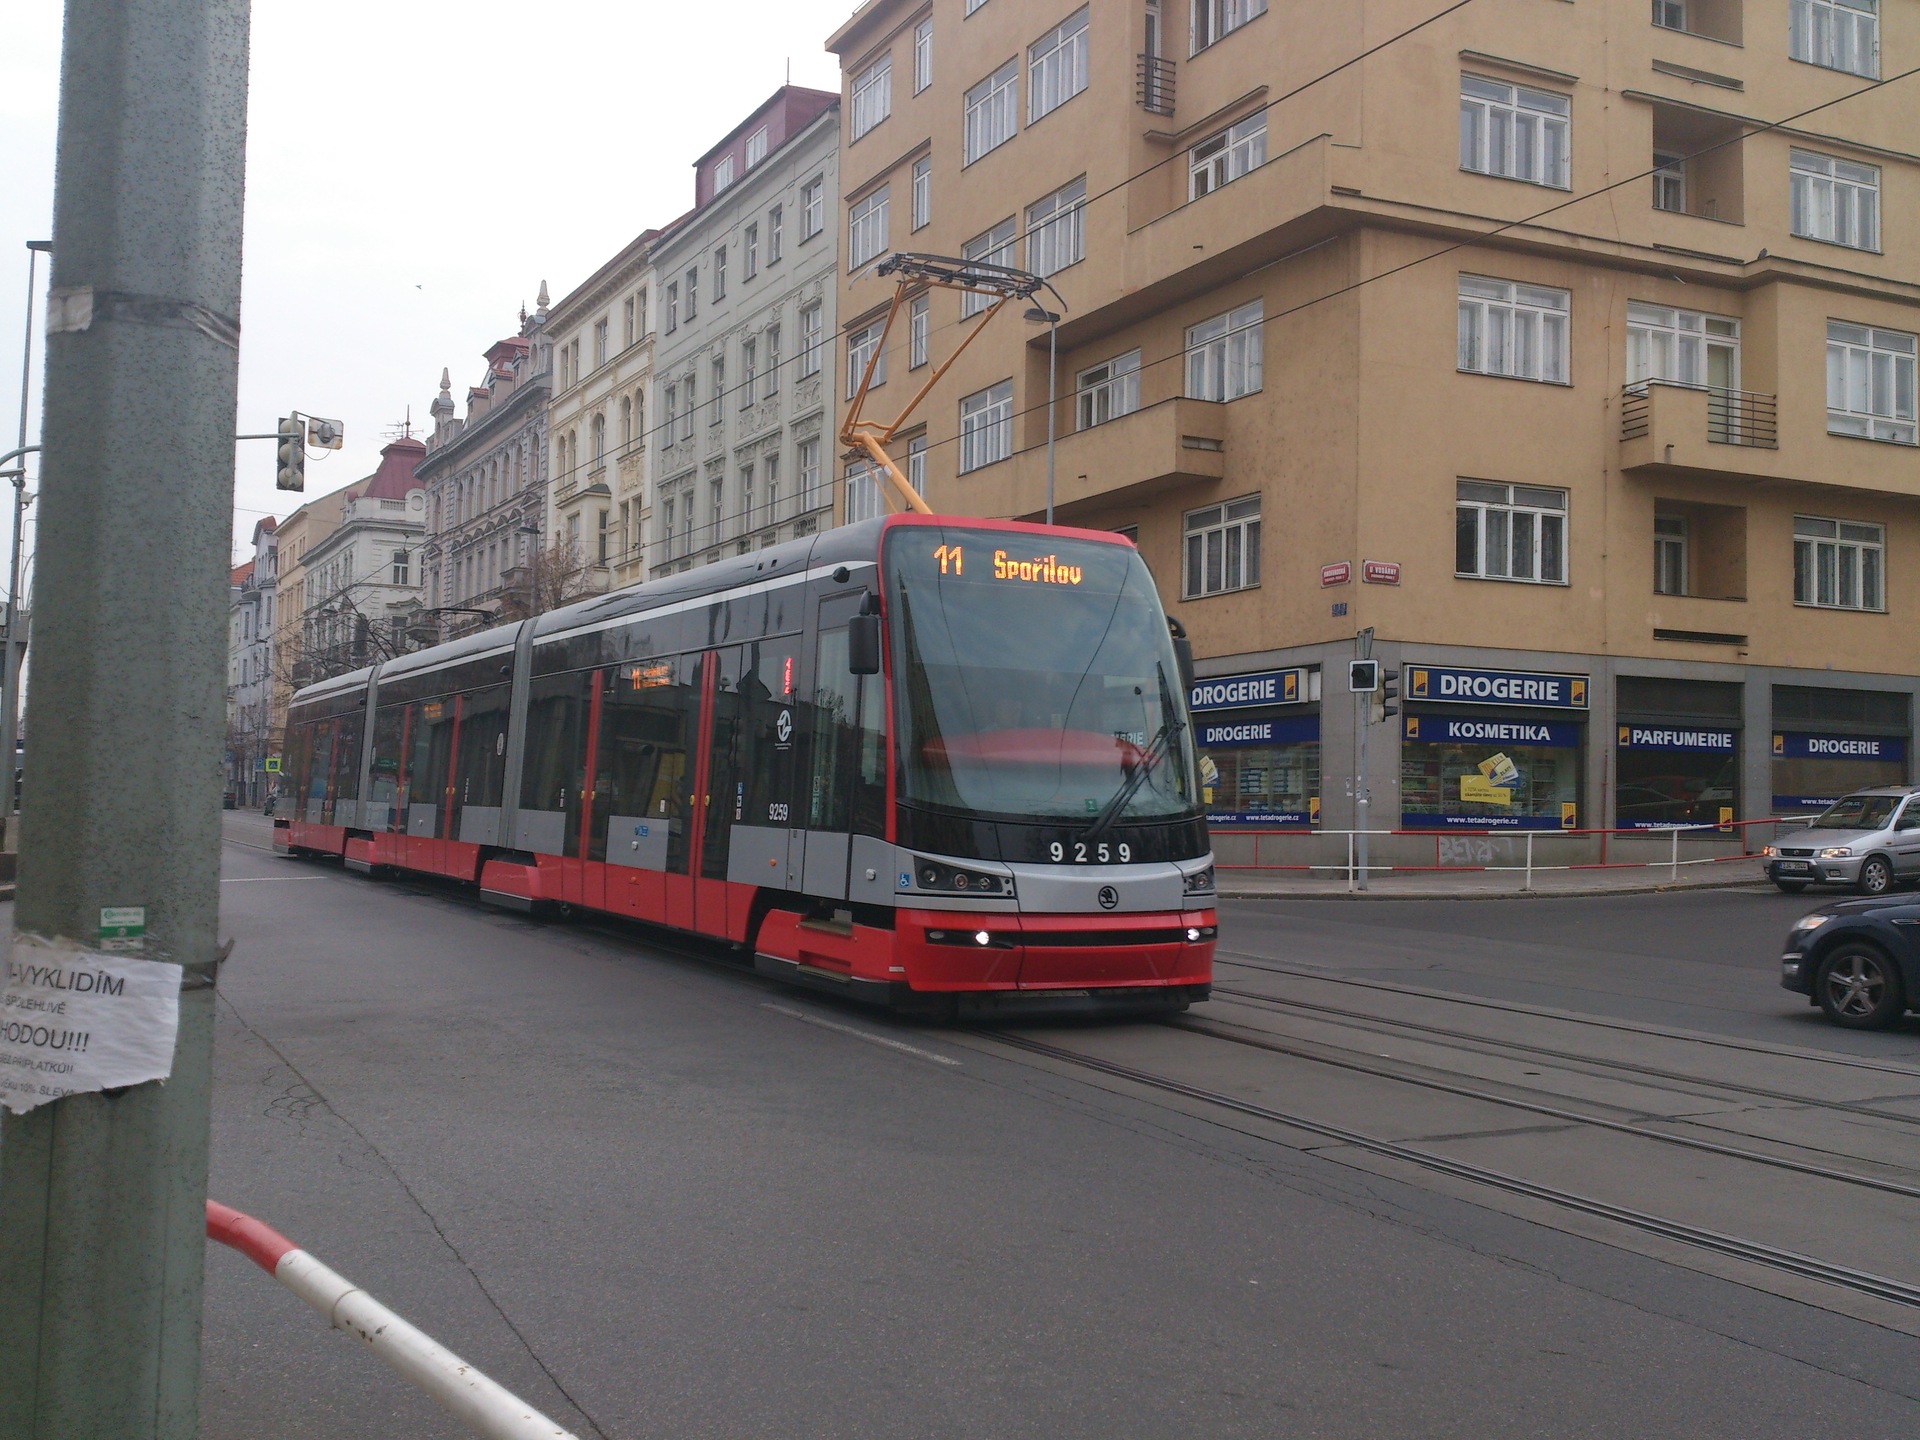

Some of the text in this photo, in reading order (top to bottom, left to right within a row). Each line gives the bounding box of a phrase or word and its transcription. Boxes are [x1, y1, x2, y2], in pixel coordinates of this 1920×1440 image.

[933, 544, 1082, 585] 11 Spořilov
[1191, 679, 1276, 706] DROGERIE
[1440, 674, 1560, 701] DROGERIE
[1206, 723, 1272, 743] DROGERIE
[1448, 721, 1551, 741] KOSMETIKA
[1633, 729, 1732, 748] PARFUMERIE
[1808, 738, 1880, 756] DROGERIE
[769, 804, 788, 821] 9259
[1246, 814, 1299, 823] www.tetadrogerie.cz
[1446, 817, 1518, 825] www.tetadrogerie.cz
[1050, 842, 1131, 862] 9259
